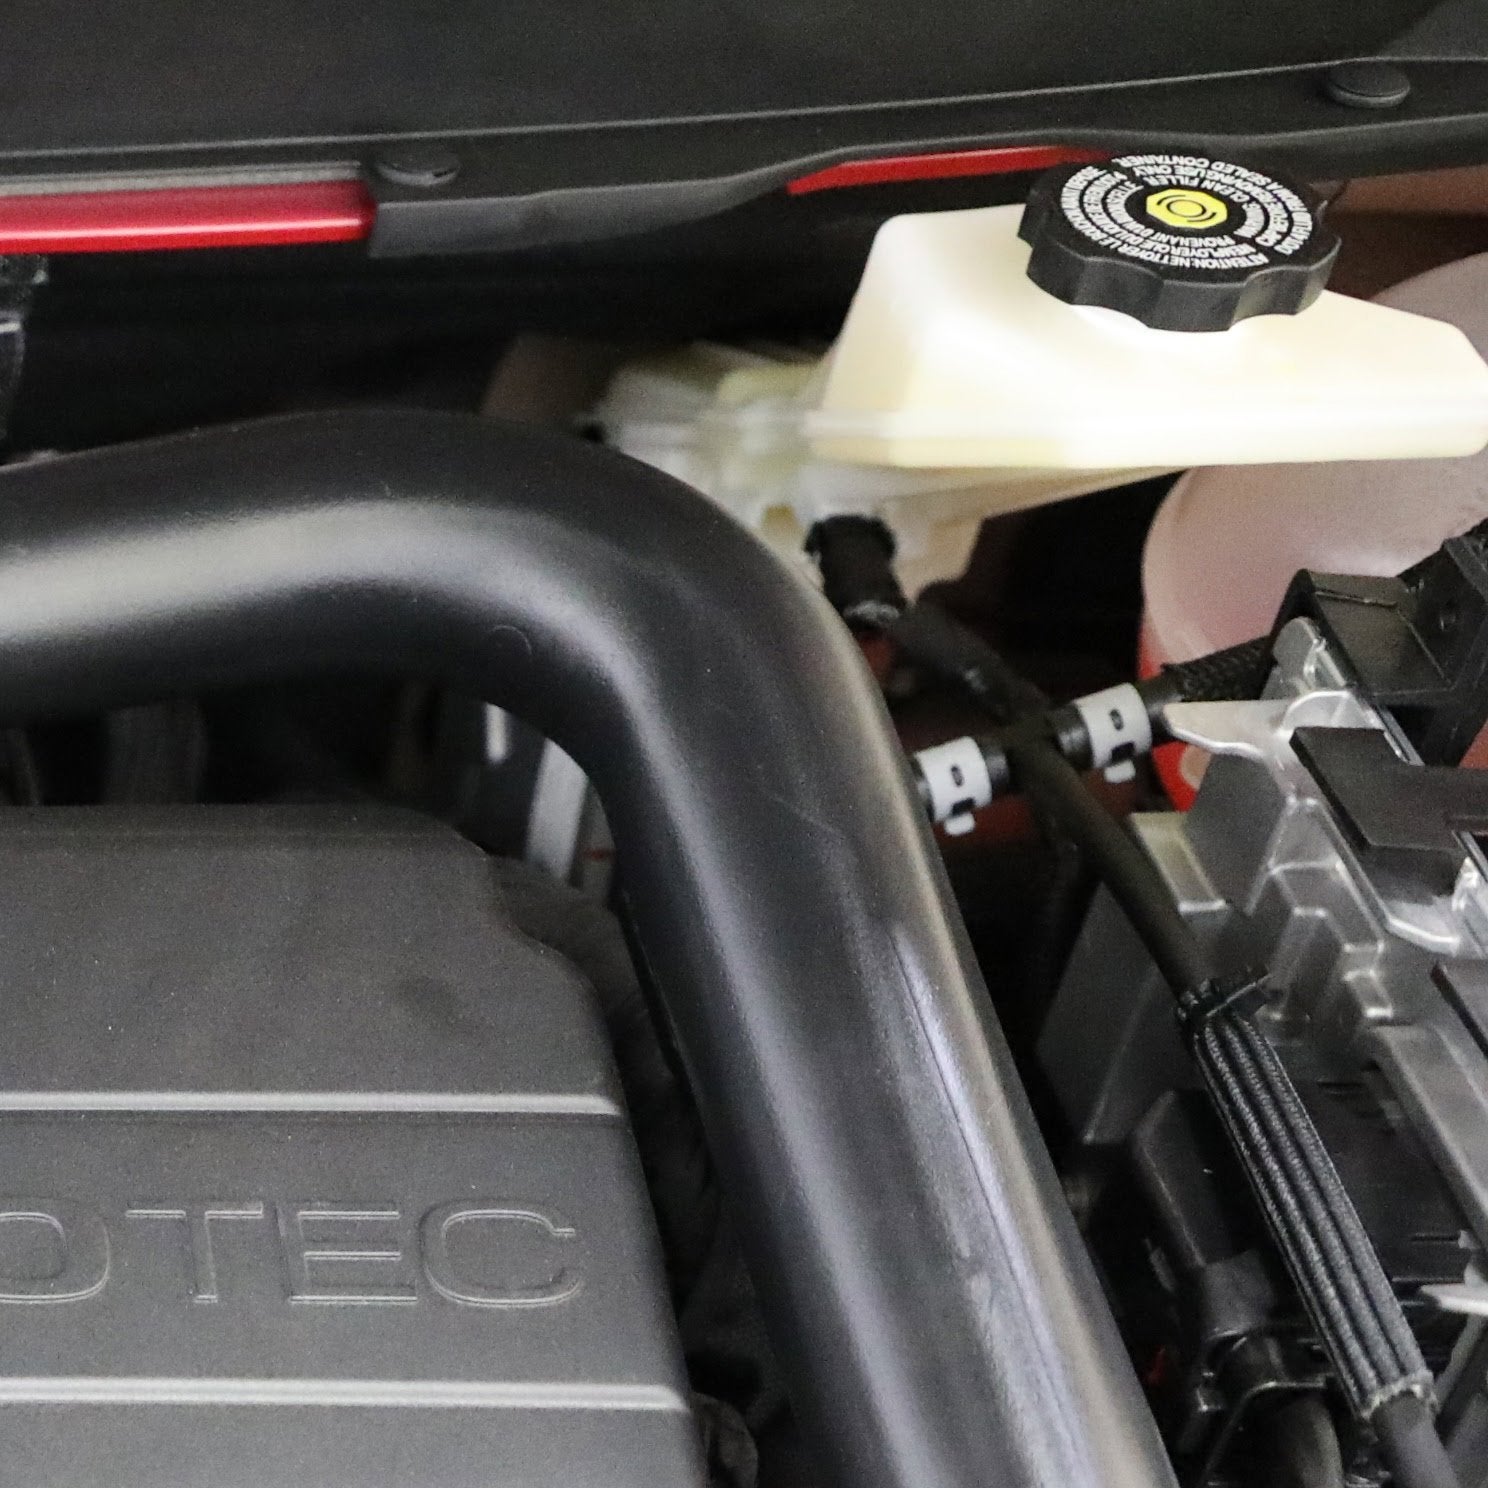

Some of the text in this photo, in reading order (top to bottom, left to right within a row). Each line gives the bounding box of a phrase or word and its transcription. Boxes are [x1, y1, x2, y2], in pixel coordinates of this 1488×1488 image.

[1133, 164, 1172, 177] ONLY
[1211, 161, 1271, 186] SEALED
[1143, 174, 1200, 187] FILLER
[1259, 181, 1283, 192] A
[1201, 179, 1250, 203] CLEAN
[1088, 212, 1128, 238] LIQUIDE
[1263, 202, 1289, 233] BEFORE
[1098, 237, 1122, 249] LE
[1150, 232, 1235, 248] PROVENANT
[1255, 229, 1282, 247] CAP
[1139, 239, 1171, 254] QUE
[1118, 243, 1191, 267] NETTOYER
[1191, 253, 1268, 269] ATTENTION:
